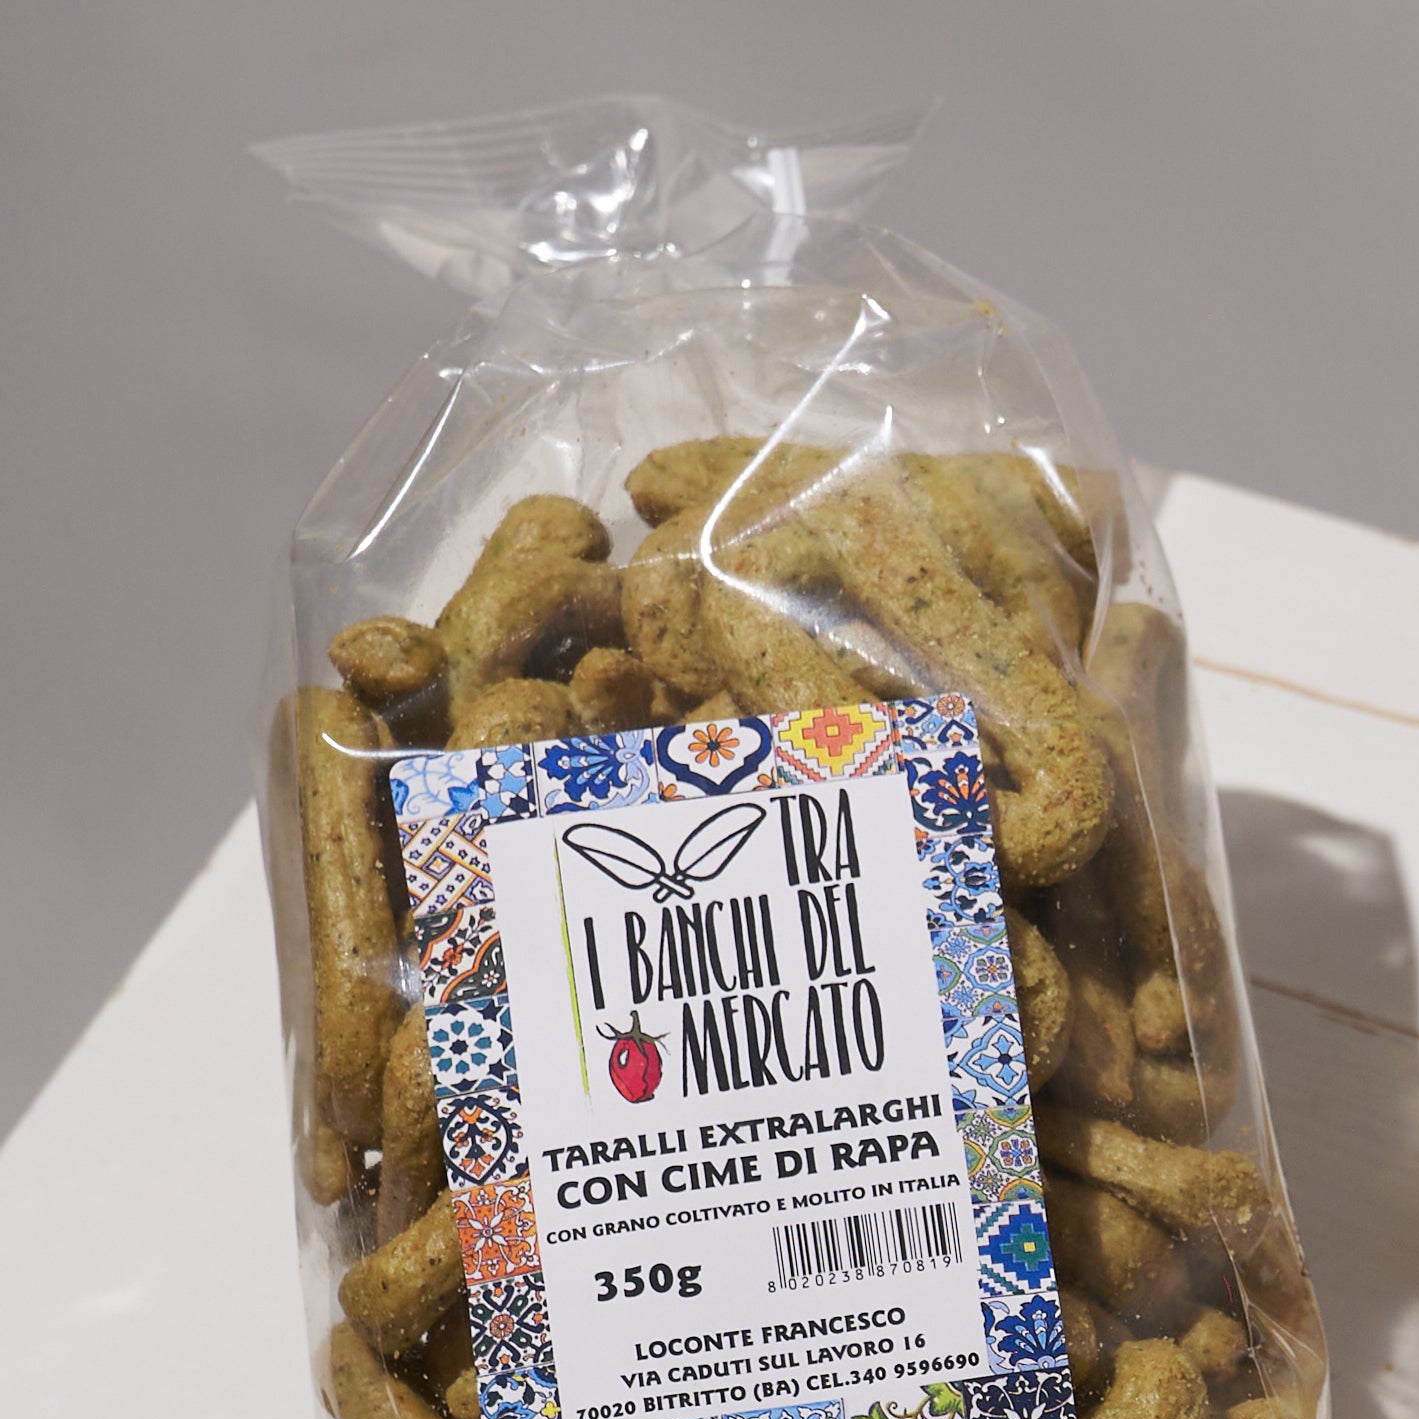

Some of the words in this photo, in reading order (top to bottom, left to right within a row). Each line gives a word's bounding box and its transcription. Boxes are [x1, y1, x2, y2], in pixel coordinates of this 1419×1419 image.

[769, 788, 861, 887] TRA
[583, 916, 606, 1011] I
[624, 894, 781, 1005] BANCHI
[797, 882, 876, 981] DEL
[682, 978, 885, 1098] MERCATO
[541, 1129, 688, 1172] TARALLI
[699, 1093, 942, 1150] EXTRALARGHI
[557, 1170, 648, 1210] CON
[661, 1154, 762, 1193] CIME
[774, 1146, 818, 1179] DI
[829, 1130, 940, 1171] RAPA
[546, 1226, 587, 1245] CON
[592, 1215, 660, 1237] GRANO
[665, 1200, 771, 1226] COLTIVATO
[776, 1198, 787, 1211] E
[791, 1186, 866, 1209] MOLITO
[871, 1182, 893, 1198] IN
[898, 1173, 961, 1194] ITALIA
[594, 1262, 703, 1302] 350g
[620, 1370, 662, 1389] VIA
[667, 1358, 752, 1383] CADUTI
[758, 1352, 800, 1372] SUL
[805, 1338, 894, 1365] LAVORO
[904, 1333, 926, 1351] 16
[634, 1329, 754, 1361] LOCONTE
[761, 1307, 906, 1345] FRANCESCO
[643, 1385, 747, 1413] BITRITTO
[753, 1378, 800, 1403] (BA)
[806, 1366, 887, 1391] CEL.340
[893, 1352, 980, 1379] 9596690
